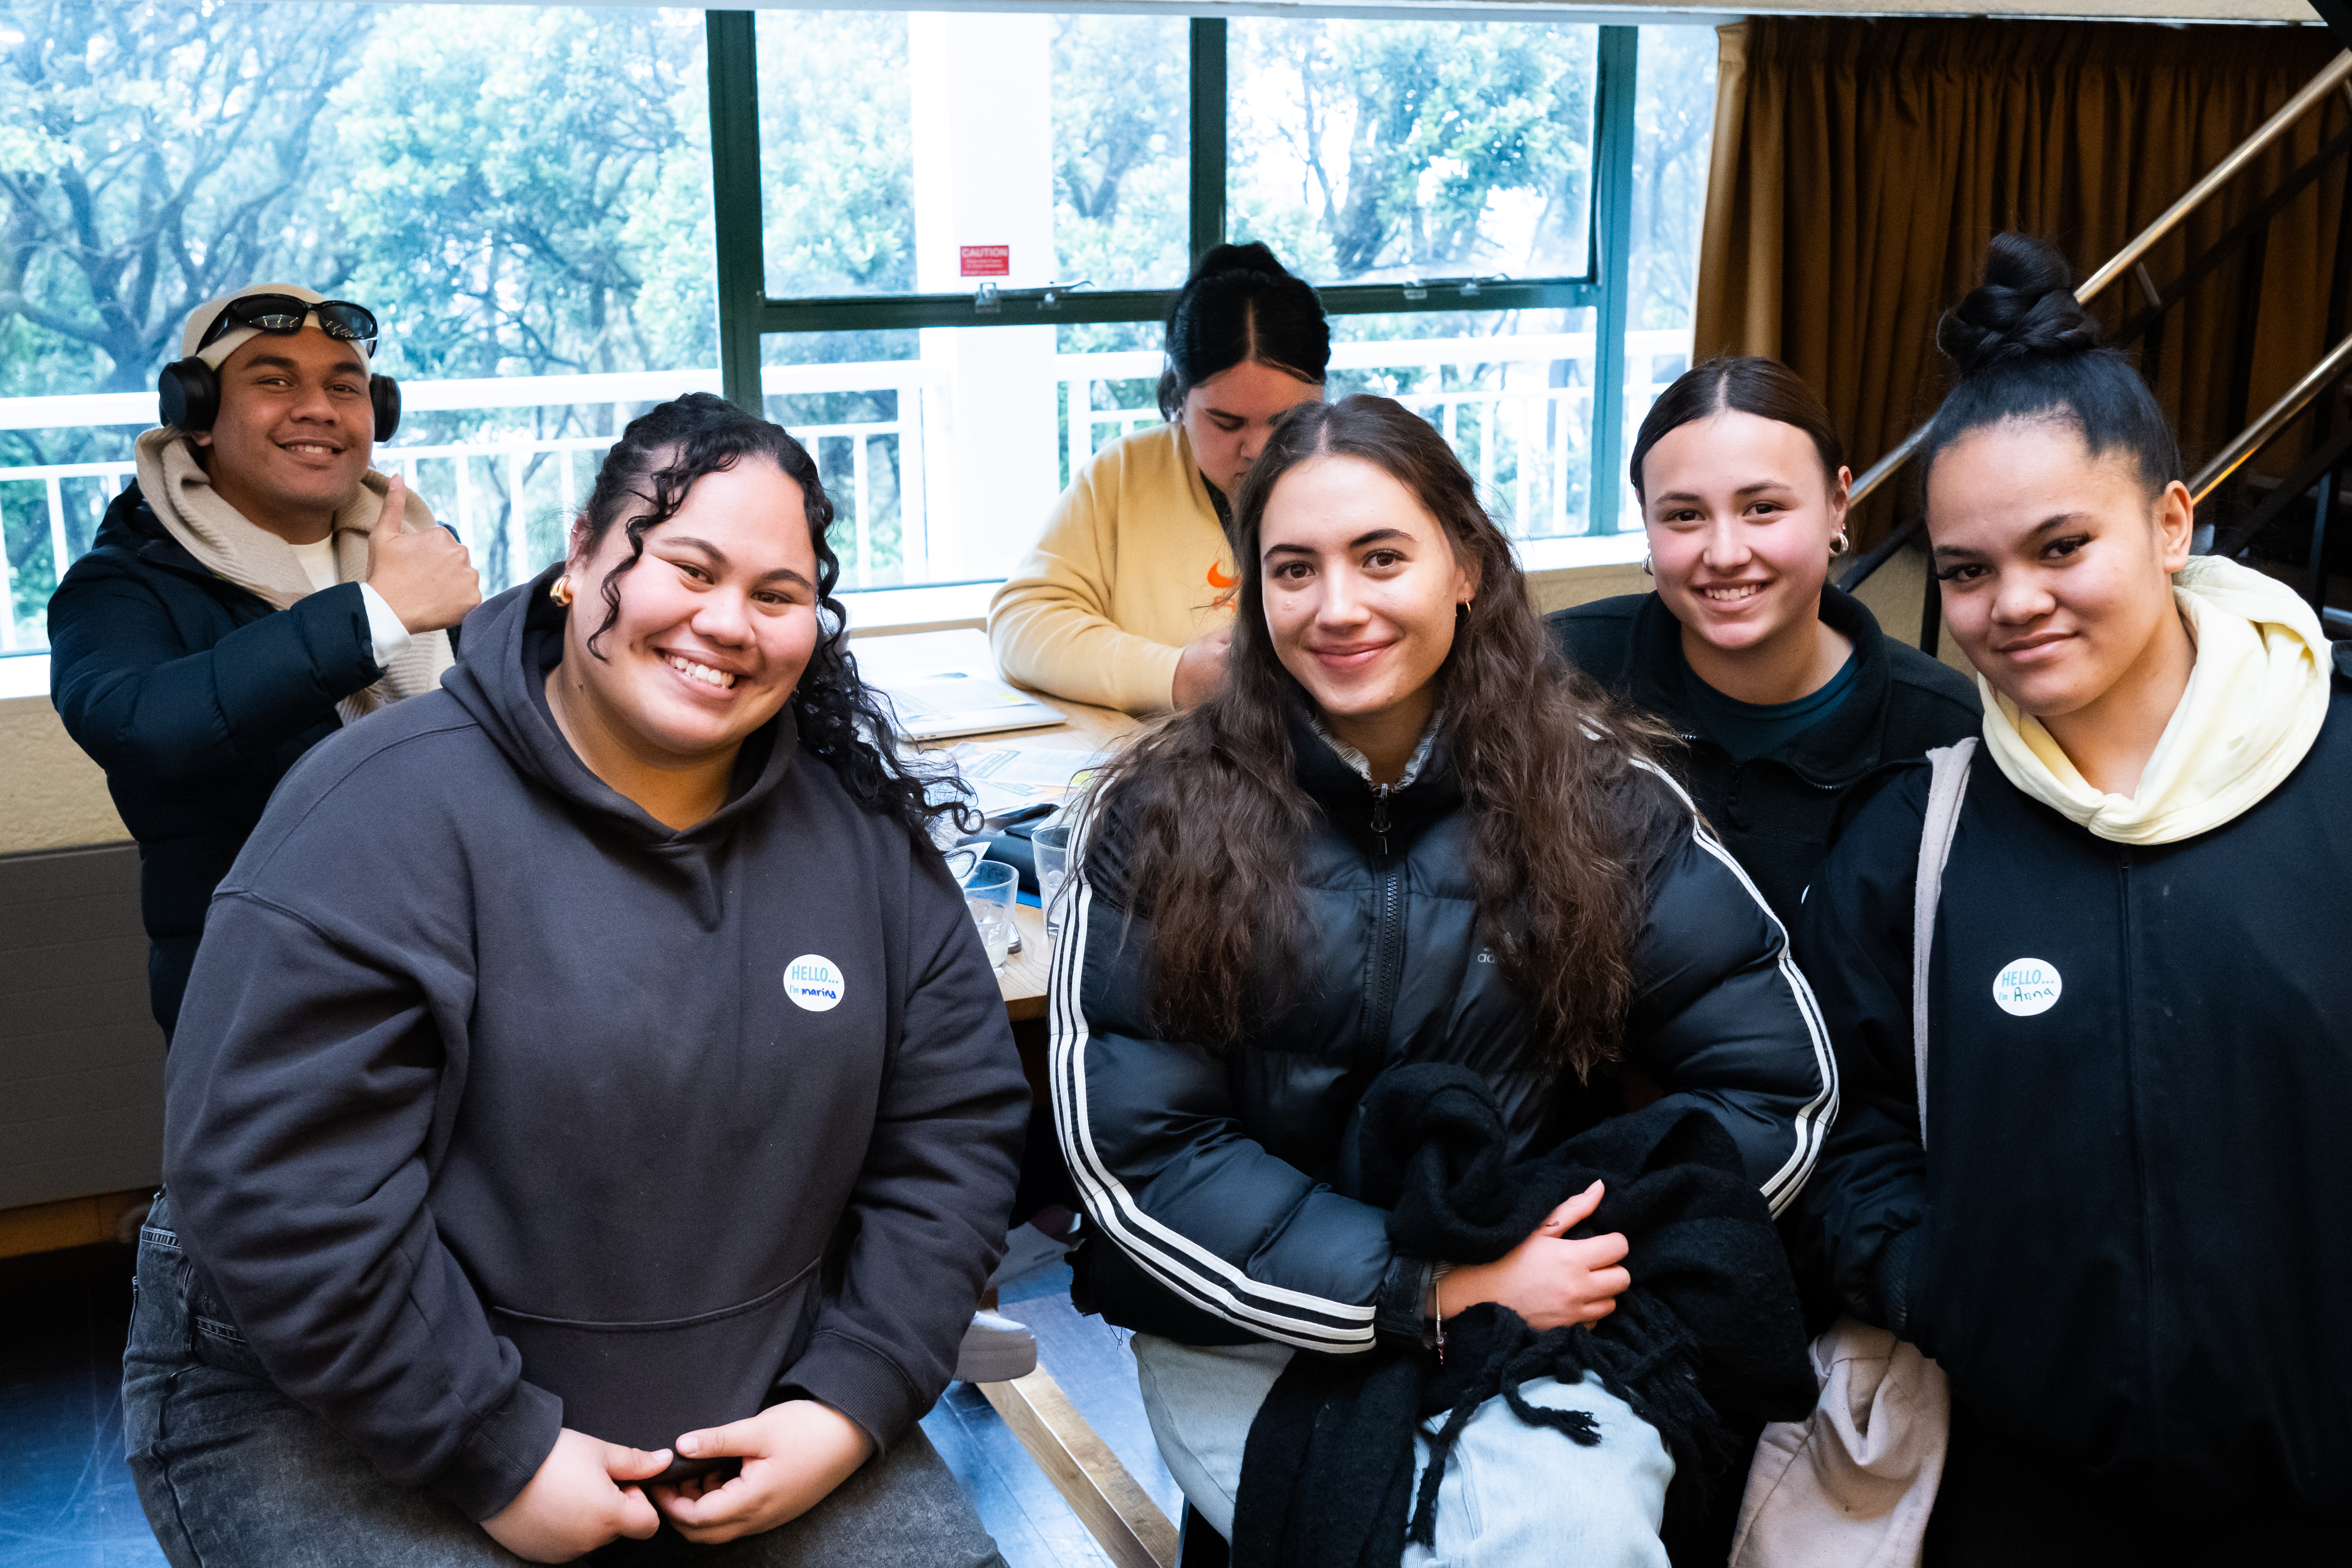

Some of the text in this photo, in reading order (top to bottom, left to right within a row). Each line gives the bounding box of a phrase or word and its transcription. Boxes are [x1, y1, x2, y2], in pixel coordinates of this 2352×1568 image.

[961, 248, 1008, 258] CAUTION
[792, 965, 839, 984] HELLO...
[2002, 970, 2054, 987] HELLO...
[790, 984, 799, 993] I'm
[2014, 987, 2054, 1002] Anna
